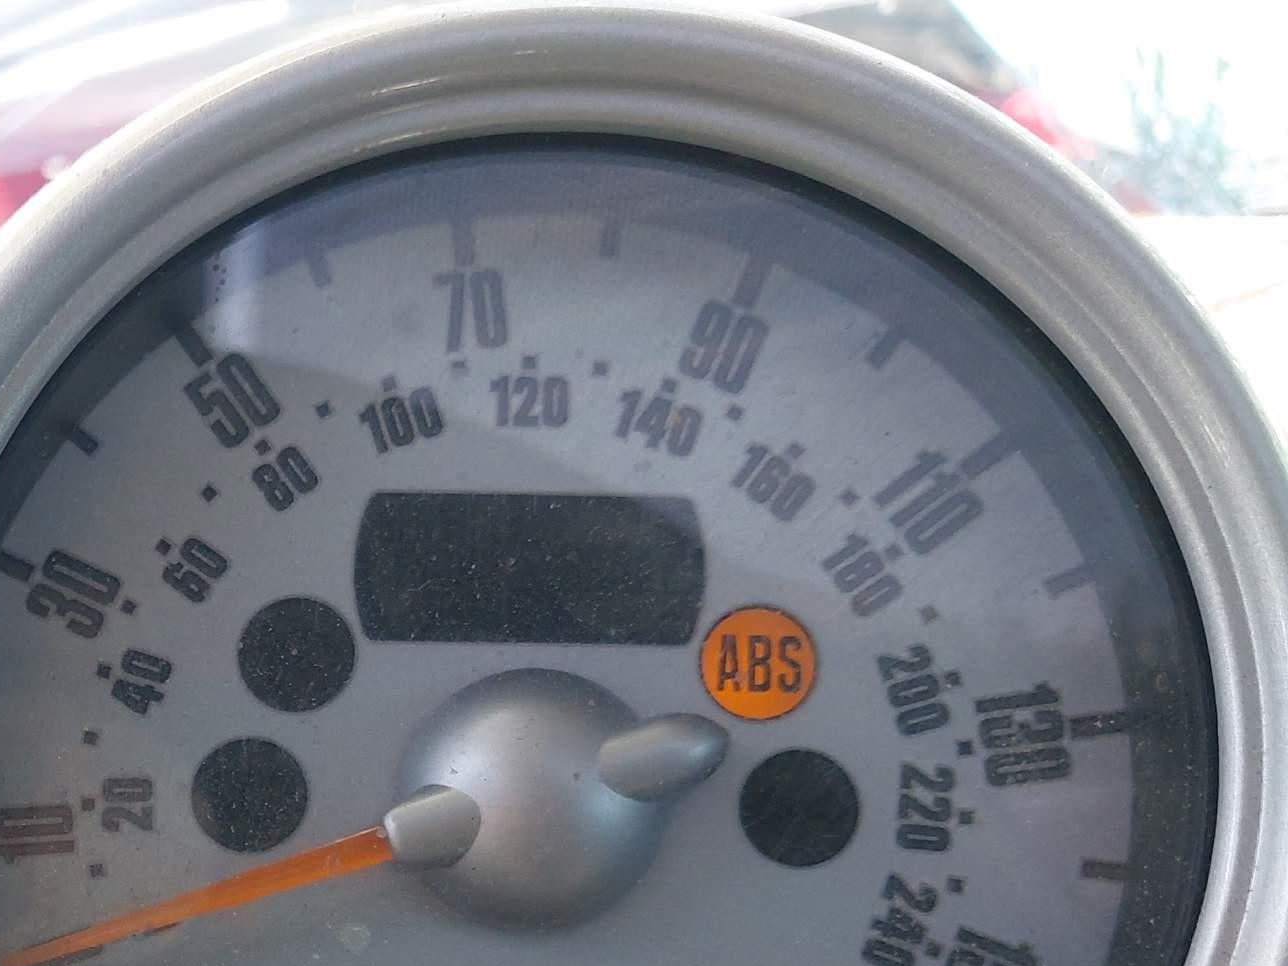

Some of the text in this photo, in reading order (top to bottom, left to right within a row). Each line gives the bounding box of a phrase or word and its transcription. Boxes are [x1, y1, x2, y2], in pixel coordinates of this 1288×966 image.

[432, 269, 508, 352] 70
[678, 302, 769, 394] 90
[184, 352, 281, 448] 50
[359, 387, 444, 454] 100
[489, 375, 569, 427] 120
[614, 387, 703, 457] 140
[252, 446, 319, 512] 80
[731, 443, 816, 521] 160
[873, 449, 983, 554] 110
[26, 549, 121, 639] 30
[161, 537, 229, 602] 60
[821, 533, 903, 617] 180
[111, 648, 172, 715] 40
[716, 634, 802, 694] ABS
[877, 644, 950, 736] 200
[975, 681, 1071, 787] 130
[102, 777, 154, 832] 20
[896, 762, 956, 852] 220
